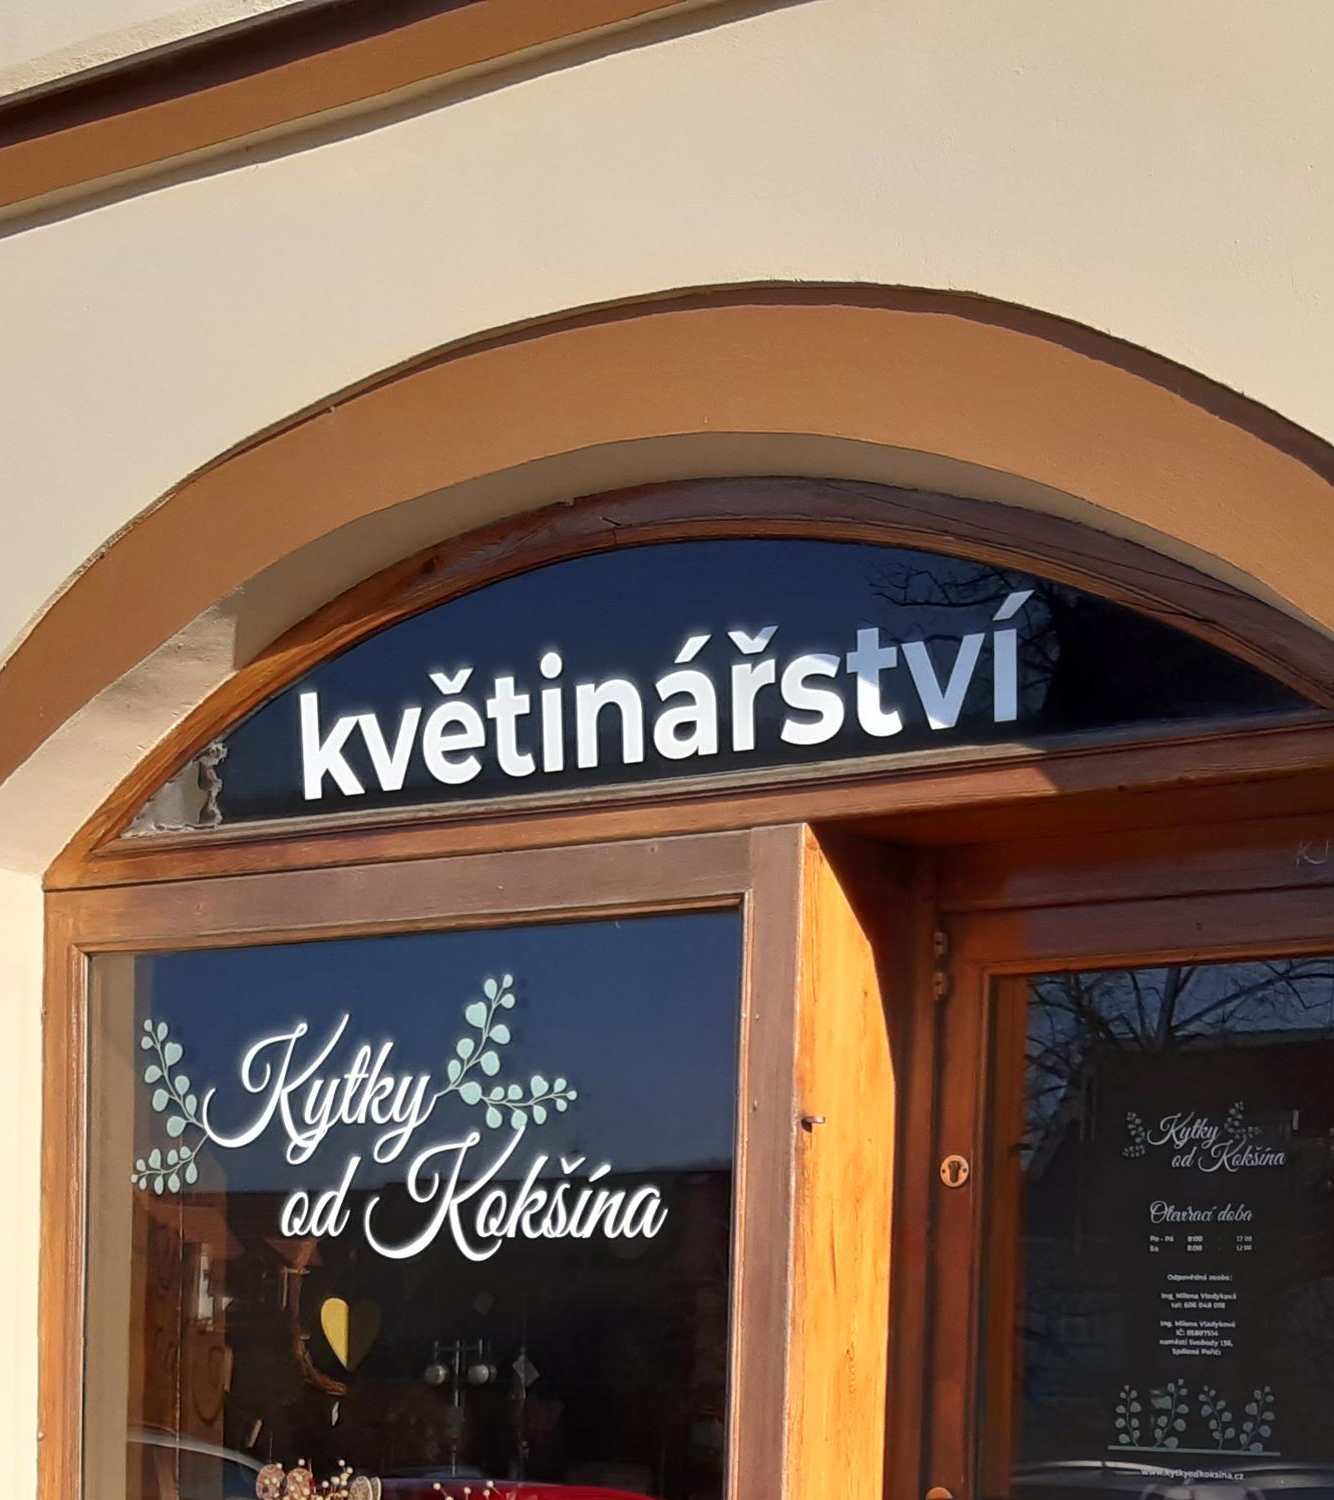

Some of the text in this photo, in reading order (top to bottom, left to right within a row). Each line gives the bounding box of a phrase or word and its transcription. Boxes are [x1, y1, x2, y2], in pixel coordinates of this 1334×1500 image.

[300, 590, 1034, 800] květinářství
[203, 1014, 437, 1165] Kytky
[1147, 1111, 1222, 1150] Kytky
[280, 1126, 668, 1262] od Kokšína
[1171, 1134, 1285, 1172] od Kokšína
[1217, 1203, 1254, 1223] doba
